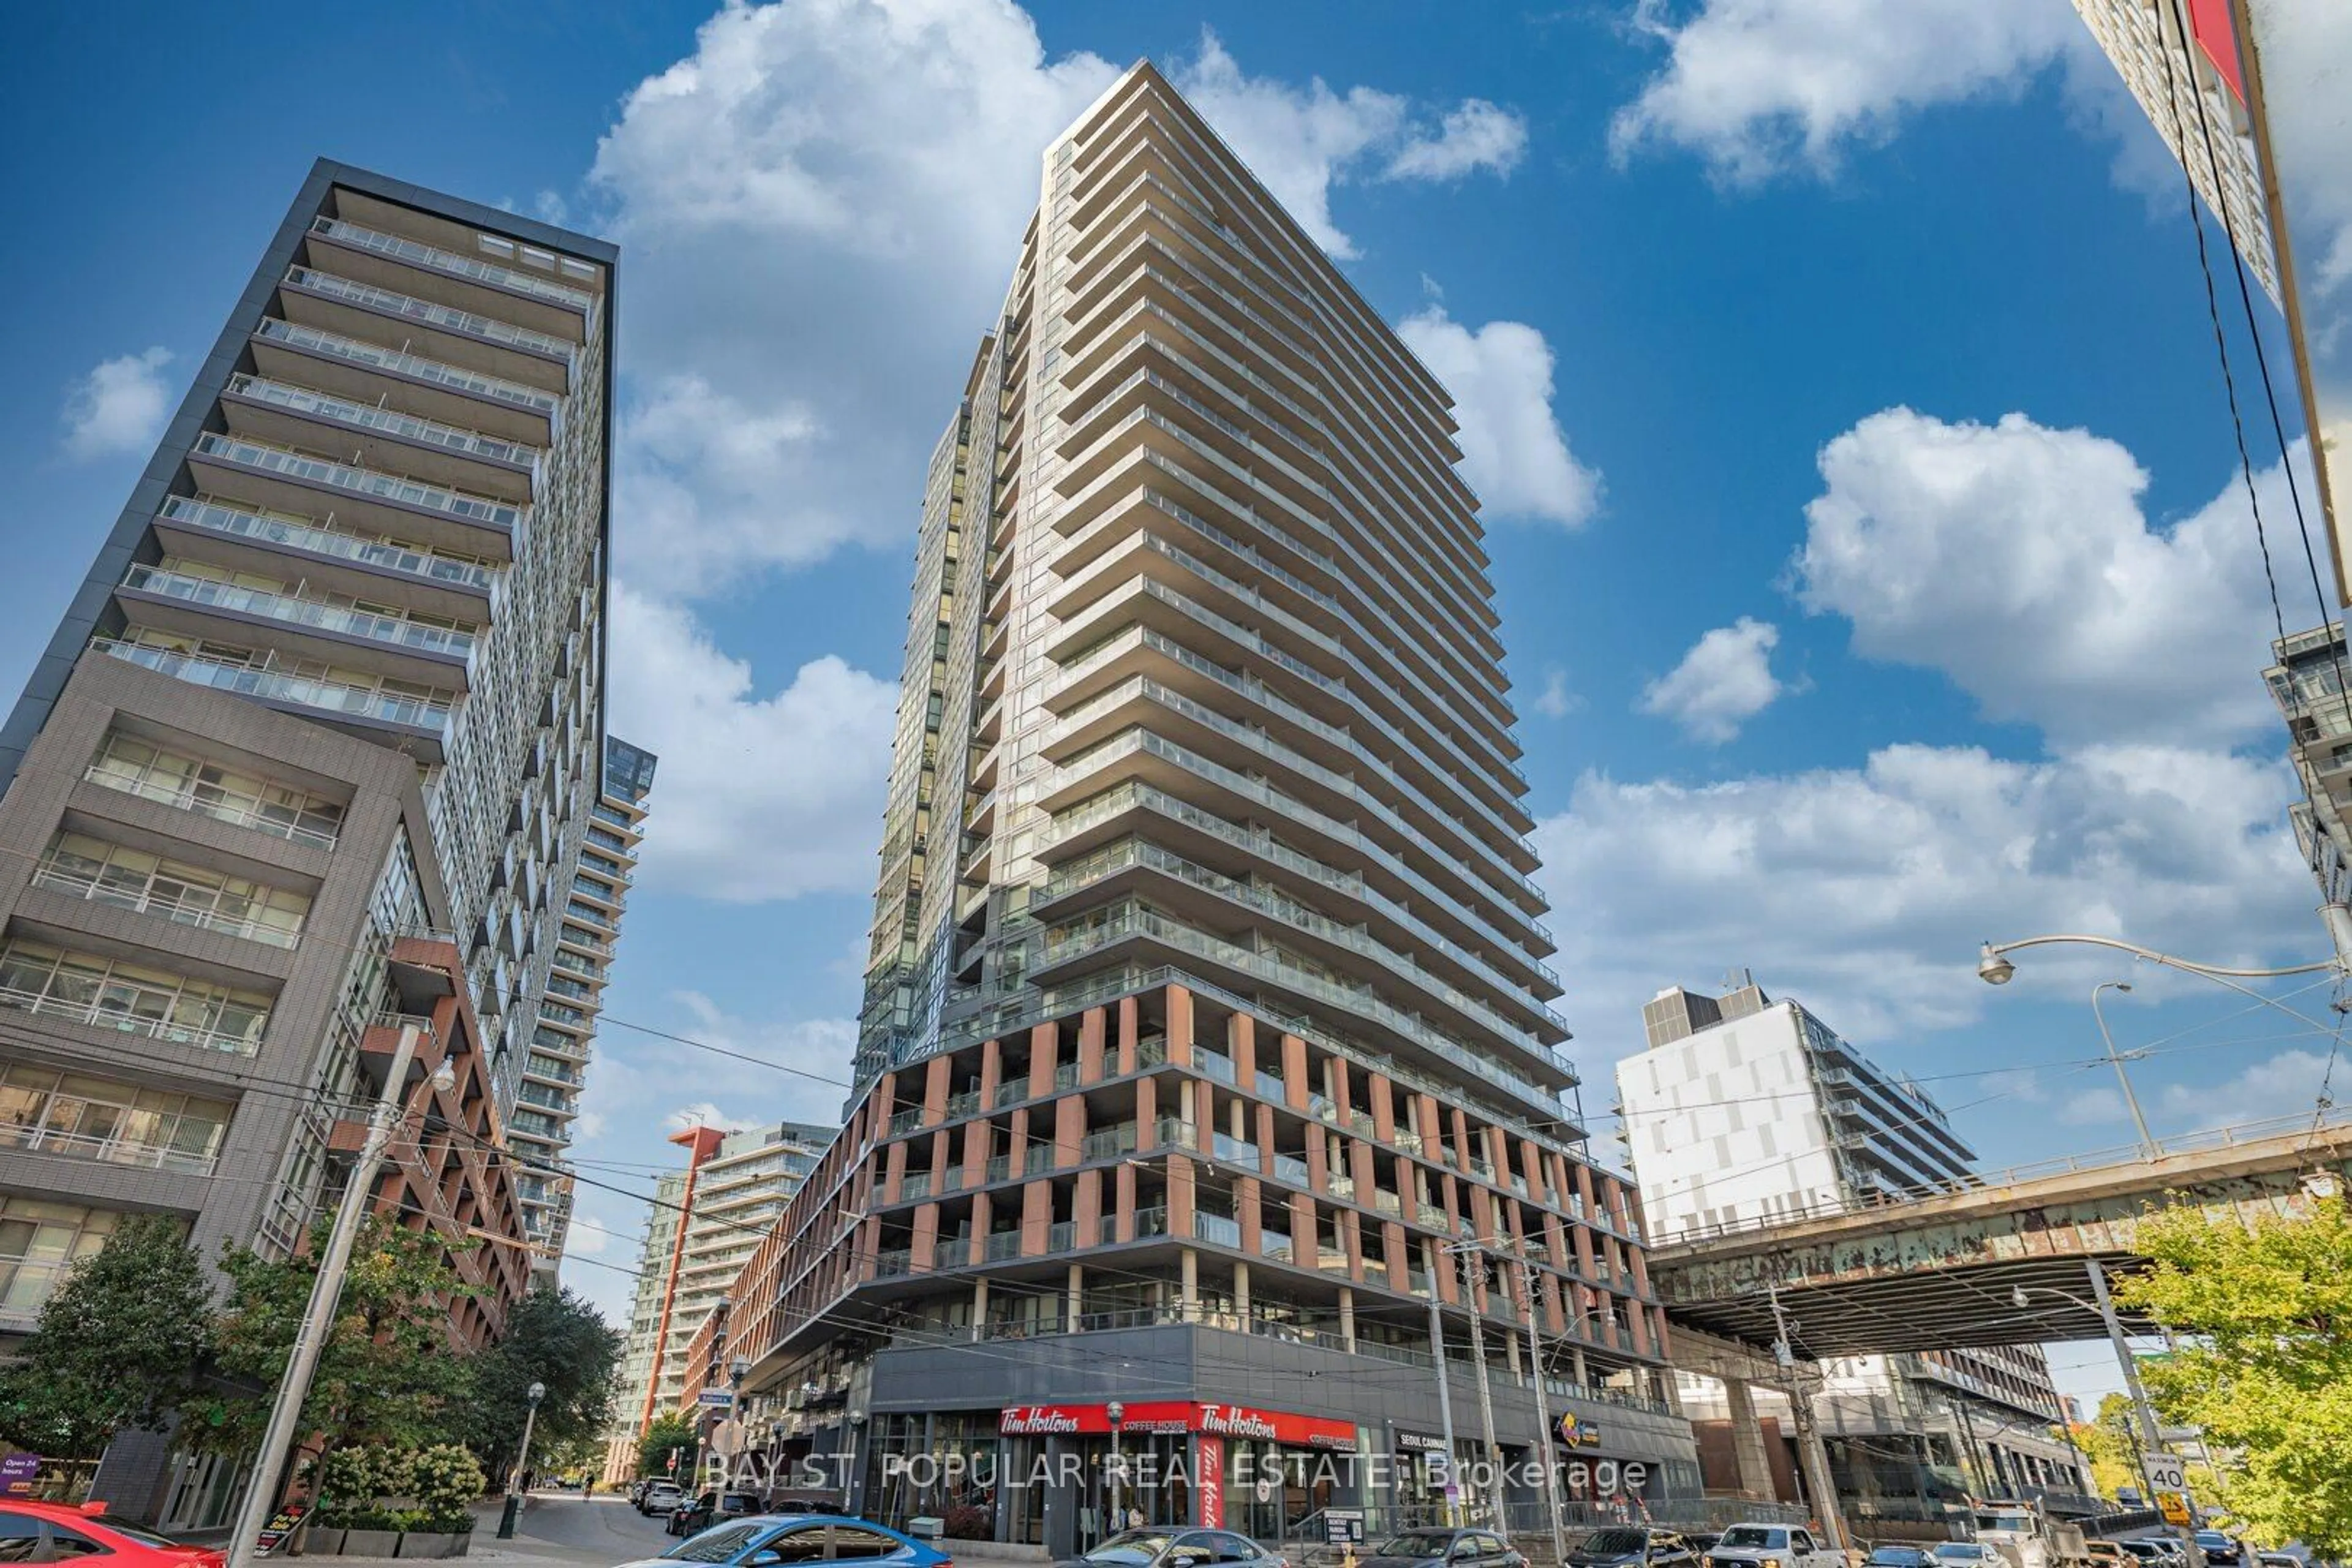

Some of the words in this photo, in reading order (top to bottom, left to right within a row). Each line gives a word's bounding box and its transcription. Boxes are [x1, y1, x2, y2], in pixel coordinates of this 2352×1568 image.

[1001, 1408, 1025, 1433] Tim
[1025, 1407, 1079, 1432] Hortons
[1123, 1420, 1156, 1431] COFFEE
[1157, 1419, 1188, 1430] HOUSE
[1200, 1404, 1227, 1433] Tim
[1227, 1406, 1276, 1439] Hortons
[1401, 1434, 1422, 1447] SEOUL
[6, 1459, 25, 1468] Open
[1204, 1445, 1218, 1477] Tim
[2154, 1469, 2182, 1487] 40
[1205, 1480, 1218, 1529] Horto
